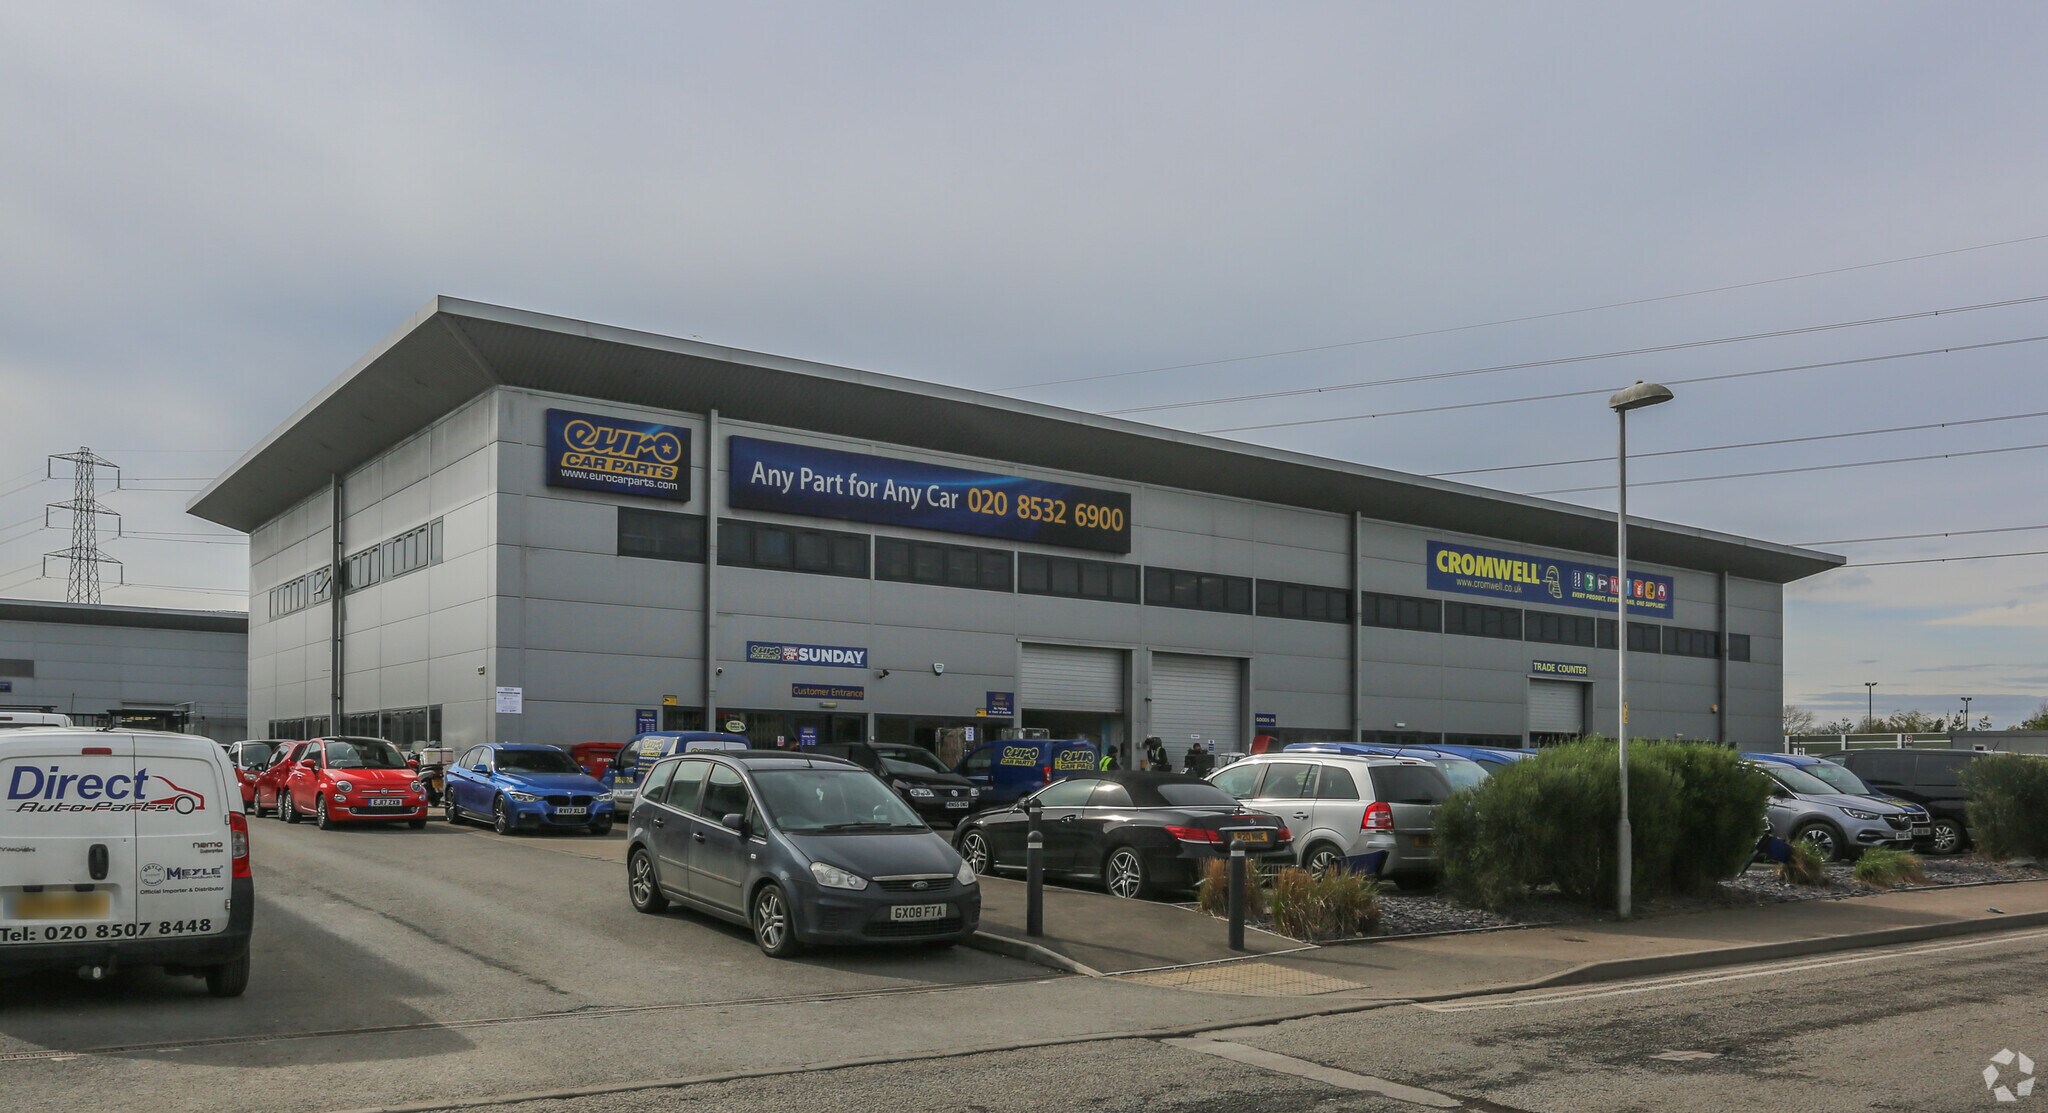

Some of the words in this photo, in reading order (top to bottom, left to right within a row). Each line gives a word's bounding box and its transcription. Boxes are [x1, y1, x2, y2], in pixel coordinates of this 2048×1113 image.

[565, 420, 681, 464] euro
[566, 453, 607, 470] CAR
[611, 458, 675, 478] PARTS
[561, 468, 678, 490] www.eurocarparts.com
[751, 462, 795, 494] Any
[800, 468, 845, 494] Part
[849, 473, 878, 497] for
[883, 478, 922, 509] Any
[927, 484, 959, 509] Car
[967, 488, 1008, 516] 020
[1017, 495, 1066, 524] 8532
[1075, 503, 1123, 531] 6900
[1436, 550, 1540, 584] CROMWELL
[1456, 578, 1522, 593] www.cromwell.co.uk
[799, 648, 864, 664] SUNDAY
[1533, 661, 1556, 673] TRADE
[1557, 663, 1587, 675] COUNTER
[793, 686, 829, 696] Customer
[832, 688, 864, 698] Entrance
[1003, 746, 1039, 760] euro
[7, 765, 149, 801] Direct
[167, 867, 220, 880] MEYLE
[895, 907, 922, 918] GX08
[924, 906, 942, 917] FTA
[0, 926, 36, 941] Tel:
[45, 925, 87, 941] 020
[96, 923, 151, 939] 8507
[159, 918, 211, 935] 8448
